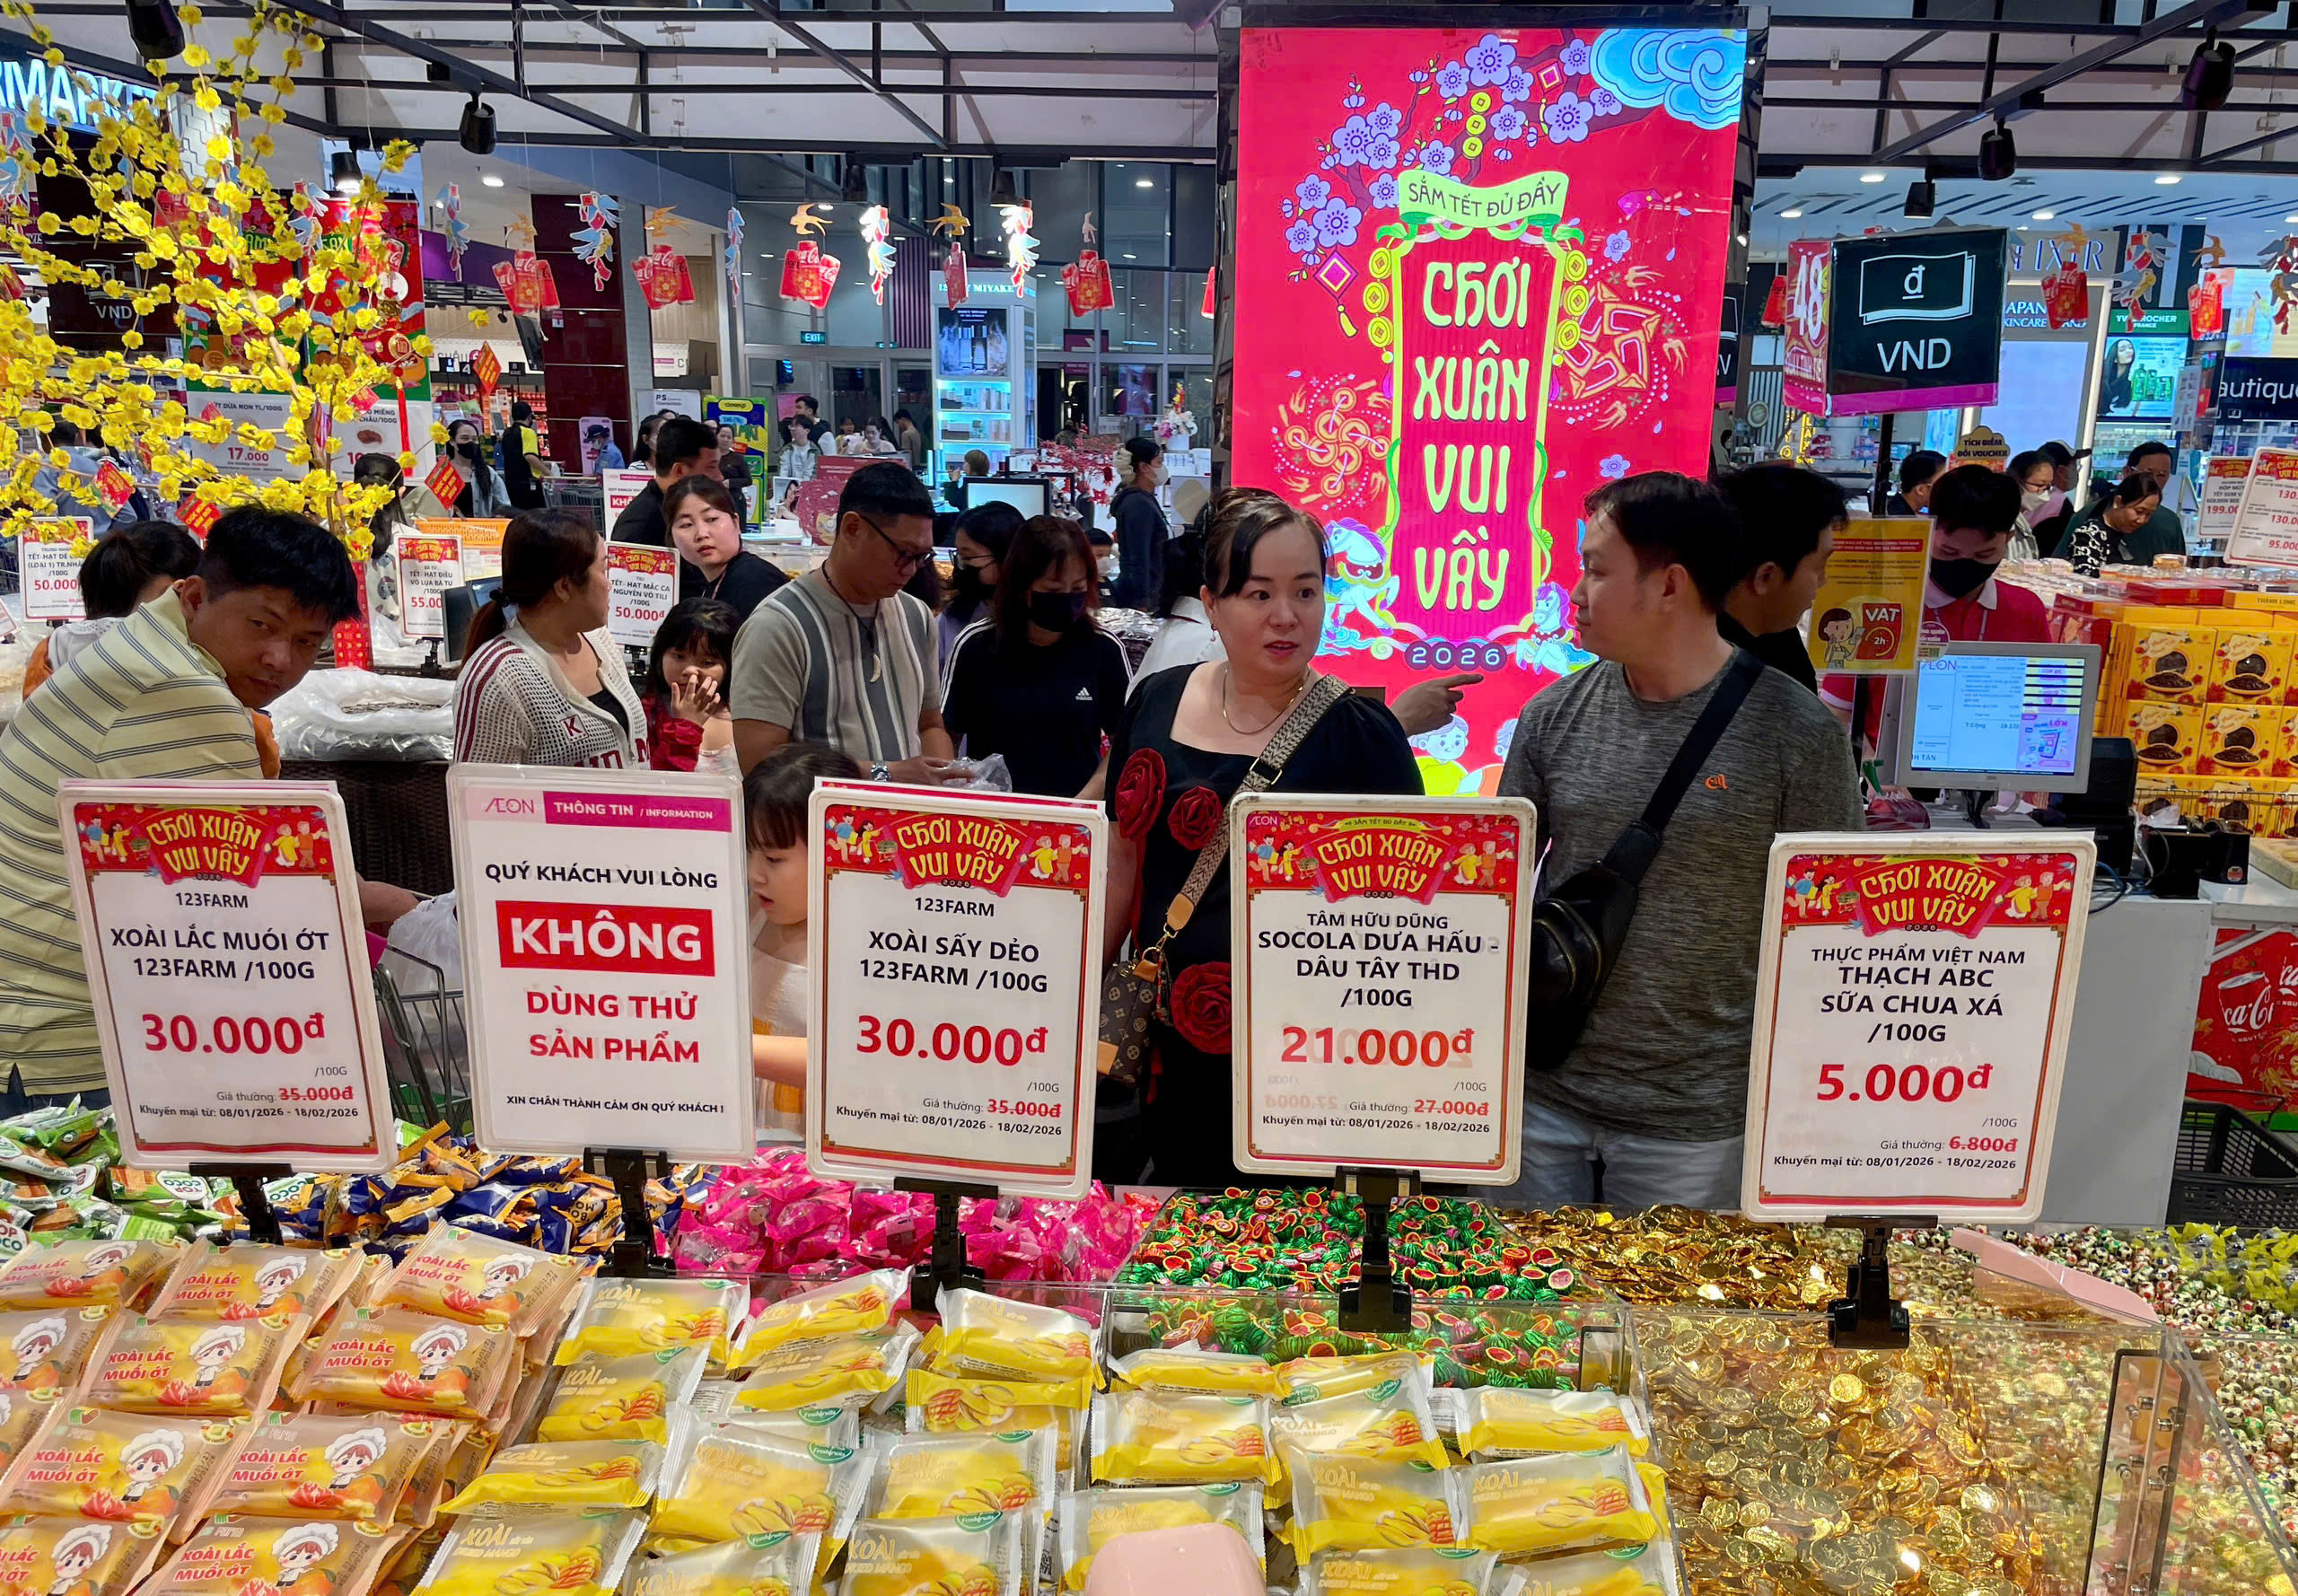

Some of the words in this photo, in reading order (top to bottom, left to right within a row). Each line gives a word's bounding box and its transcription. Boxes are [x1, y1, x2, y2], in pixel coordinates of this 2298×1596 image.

[1408, 178, 1446, 210] SẮM
[1449, 187, 1483, 218] TẾT
[1486, 191, 1513, 218] ĐỦ
[1517, 177, 1561, 212] ĐẦY
[973, 285, 1014, 293] MIYAKE
[95, 305, 133, 320] VND
[804, 333, 821, 342] EXIT
[1876, 338, 1952, 373] VND
[1413, 338, 1530, 421] XUÂN
[227, 447, 269, 461] 17.000
[1424, 444, 1511, 514] VUI
[1414, 525, 1511, 611] VẦY
[615, 605, 665, 622] 50.000đ
[630, 598, 651, 608] /100G
[1864, 608, 1900, 622] VAT
[1873, 636, 1886, 645] 2h
[1411, 646, 1501, 668] 2026
[563, 716, 583, 737] K
[554, 800, 606, 816] THÔNG
[610, 803, 634, 817] TIN
[645, 808, 714, 820] INFORMATION
[1379, 834, 1443, 871] XUÂN
[486, 860, 531, 882] QUÝ
[537, 864, 611, 884] KHÁCH
[617, 869, 654, 886] VUI
[661, 867, 718, 890] LÒNG
[1330, 865, 1372, 892] VUI
[1377, 861, 1428, 895] VẦY
[175, 892, 250, 908] 123FARM
[1364, 889, 1395, 899] 2026
[915, 898, 996, 917] 123FARM
[1307, 909, 1346, 927] TÂM
[1350, 909, 1391, 928] HỮU
[1396, 911, 1449, 930] DŨNG
[110, 924, 167, 948] XOÀI
[174, 924, 216, 950] LẮC
[295, 927, 329, 951] ỚT
[510, 909, 702, 963] KHÔNG
[868, 927, 928, 954] XOÀI
[935, 932, 982, 959] SẤY
[990, 938, 1039, 963] DẺO
[1258, 930, 1356, 951] SOCOLA
[1364, 931, 1419, 953] DƯA
[1426, 930, 1482, 954] HẤU
[1811, 947, 1863, 965] THỰC
[1868, 943, 1926, 963] PHẨM
[1933, 945, 1975, 966] VIỆT
[1978, 951, 2026, 965] NAM
[133, 957, 237, 978] 123FARM
[244, 960, 315, 982] /100G
[860, 959, 969, 987] 123FARM
[976, 968, 1048, 994] /100G
[1296, 954, 1348, 979] DÂU
[1355, 956, 1401, 980] TÂY
[1408, 961, 1460, 981] THD
[1838, 967, 1931, 990] THẠCH
[1939, 968, 1995, 988] ABC
[526, 986, 619, 1018] DÙNG
[628, 990, 699, 1021] THỬ
[1340, 988, 1414, 1009] /100G
[1820, 990, 1874, 1014] SỮA
[1882, 995, 1958, 1016] CHUA
[1966, 992, 2004, 1017] XÁ
[141, 1013, 327, 1055] 30.000đ
[855, 1014, 1048, 1066] 30.000đ
[1867, 1023, 1948, 1045] /100G
[530, 1028, 594, 1060] SẢN
[604, 1030, 700, 1064] PHẨM
[1280, 1027, 1475, 1068] 21.000đ
[1453, 1080, 1487, 1092] /100G
[1816, 1063, 1995, 1104] 5.000đ
[506, 1095, 527, 1106] XIN
[529, 1094, 561, 1107] CHÂN
[562, 1096, 601, 1109] THÀNH
[604, 1097, 629, 1111] CẢM
[631, 1100, 650, 1111] ƠN
[652, 1100, 676, 1113] QUÝ
[678, 1101, 719, 1114] KHÁCH
[1349, 1101, 1367, 1111] Giá
[1369, 1101, 1412, 1116] thường:
[1414, 1100, 1490, 1117] 27.000đ
[1982, 1117, 2019, 1129] /100G
[1881, 1139, 1899, 1152] Giá
[1901, 1139, 1946, 1153] thường:
[1949, 1136, 2019, 1153] 6.800đ
[1774, 1155, 1818, 1169] Khuyến
[1820, 1155, 1842, 1169] mại
[1845, 1155, 1864, 1168] từ:
[1866, 1155, 1934, 1168] 08/01/2026
[1946, 1156, 2017, 1170] 18/02/2026
